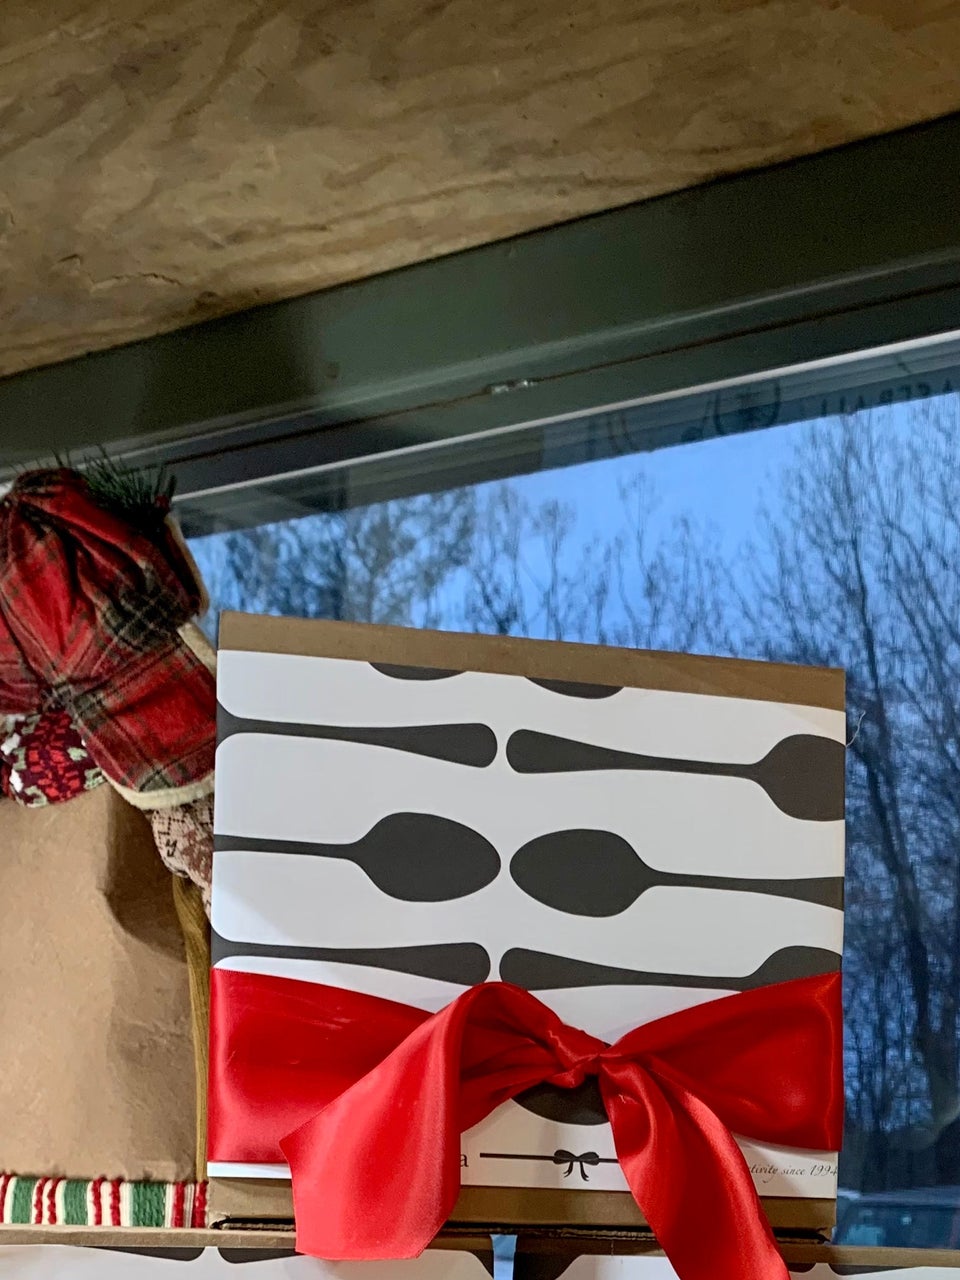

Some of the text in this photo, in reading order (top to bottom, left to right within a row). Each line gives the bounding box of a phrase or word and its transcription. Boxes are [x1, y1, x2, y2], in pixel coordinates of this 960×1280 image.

[751, 1164, 837, 1183] tivity since 1994
